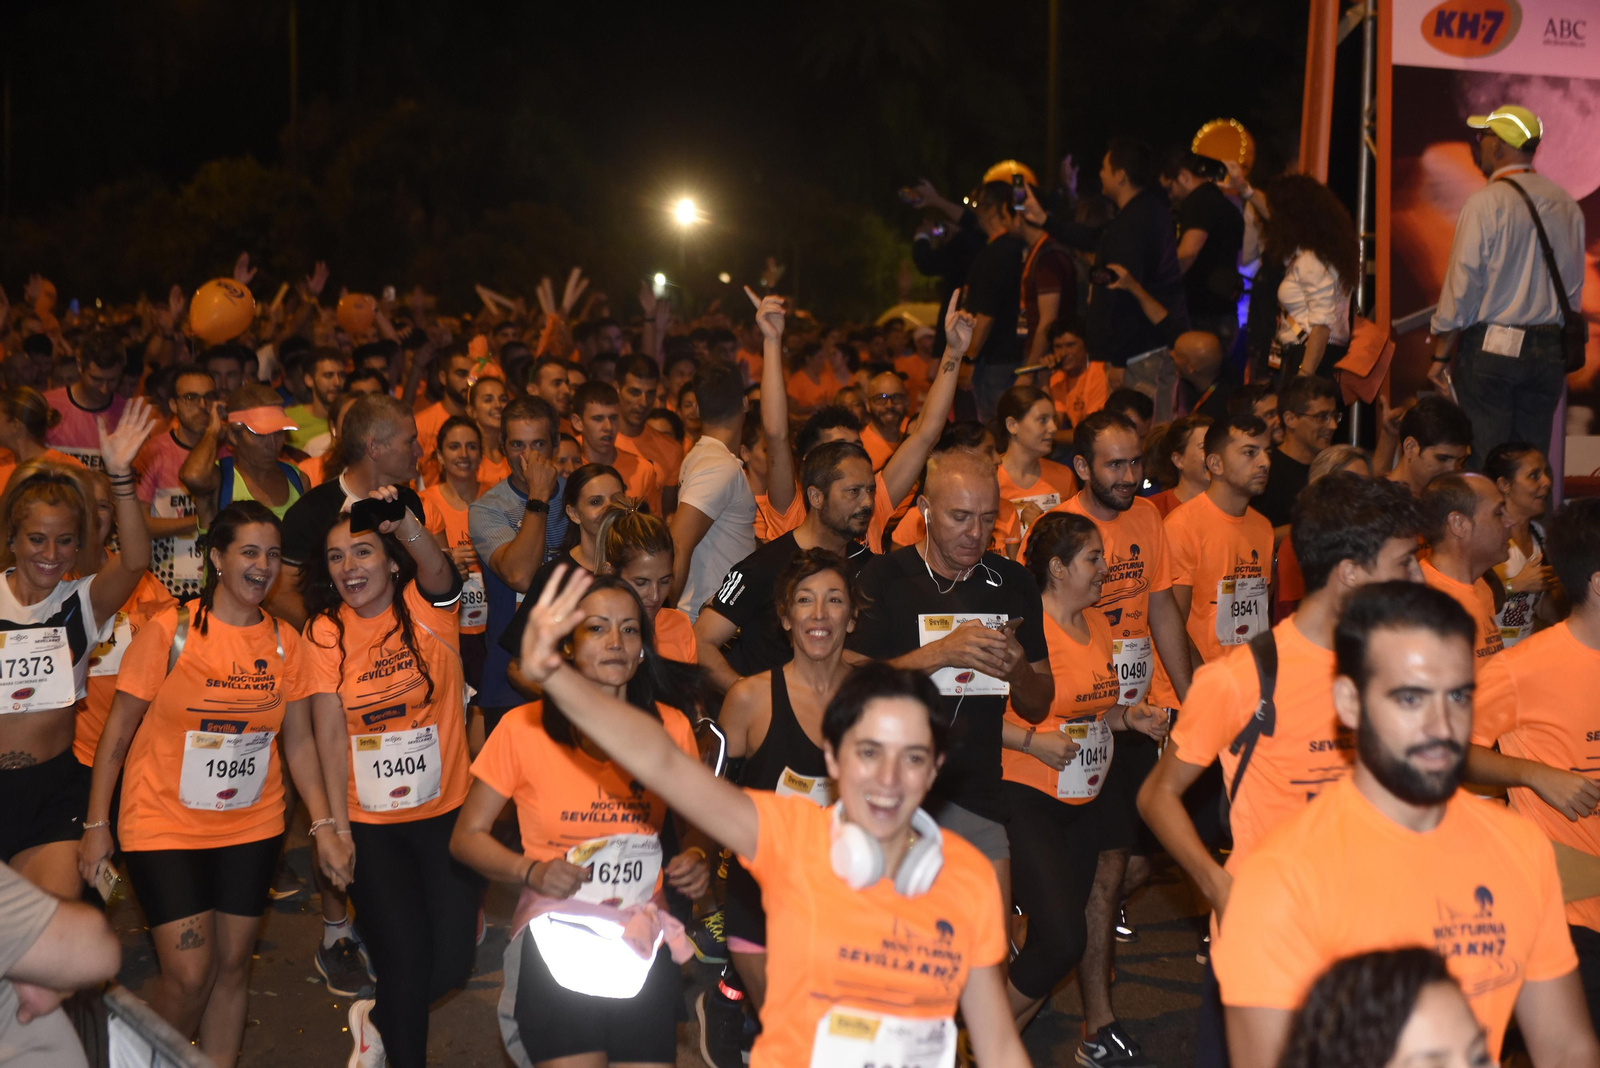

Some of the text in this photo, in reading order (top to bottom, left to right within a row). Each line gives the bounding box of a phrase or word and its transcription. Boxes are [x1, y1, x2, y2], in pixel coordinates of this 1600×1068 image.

[1543, 18, 1587, 40] ABC
[1231, 600, 1258, 618] 19541
[227, 674, 276, 682] NOCTURNA
[356, 666, 396, 684] SEVILLA
[1114, 661, 1147, 680] 10490
[205, 679, 276, 691] SEVILLA KH7
[1075, 690, 1107, 703] SEVILLA
[372, 754, 426, 778] 13404
[1079, 746, 1107, 767] 10414
[206, 757, 255, 778] 19845
[559, 811, 618, 823] SEVILLA
[586, 860, 643, 884] 16250
[838, 947, 914, 972] SEVILLA
